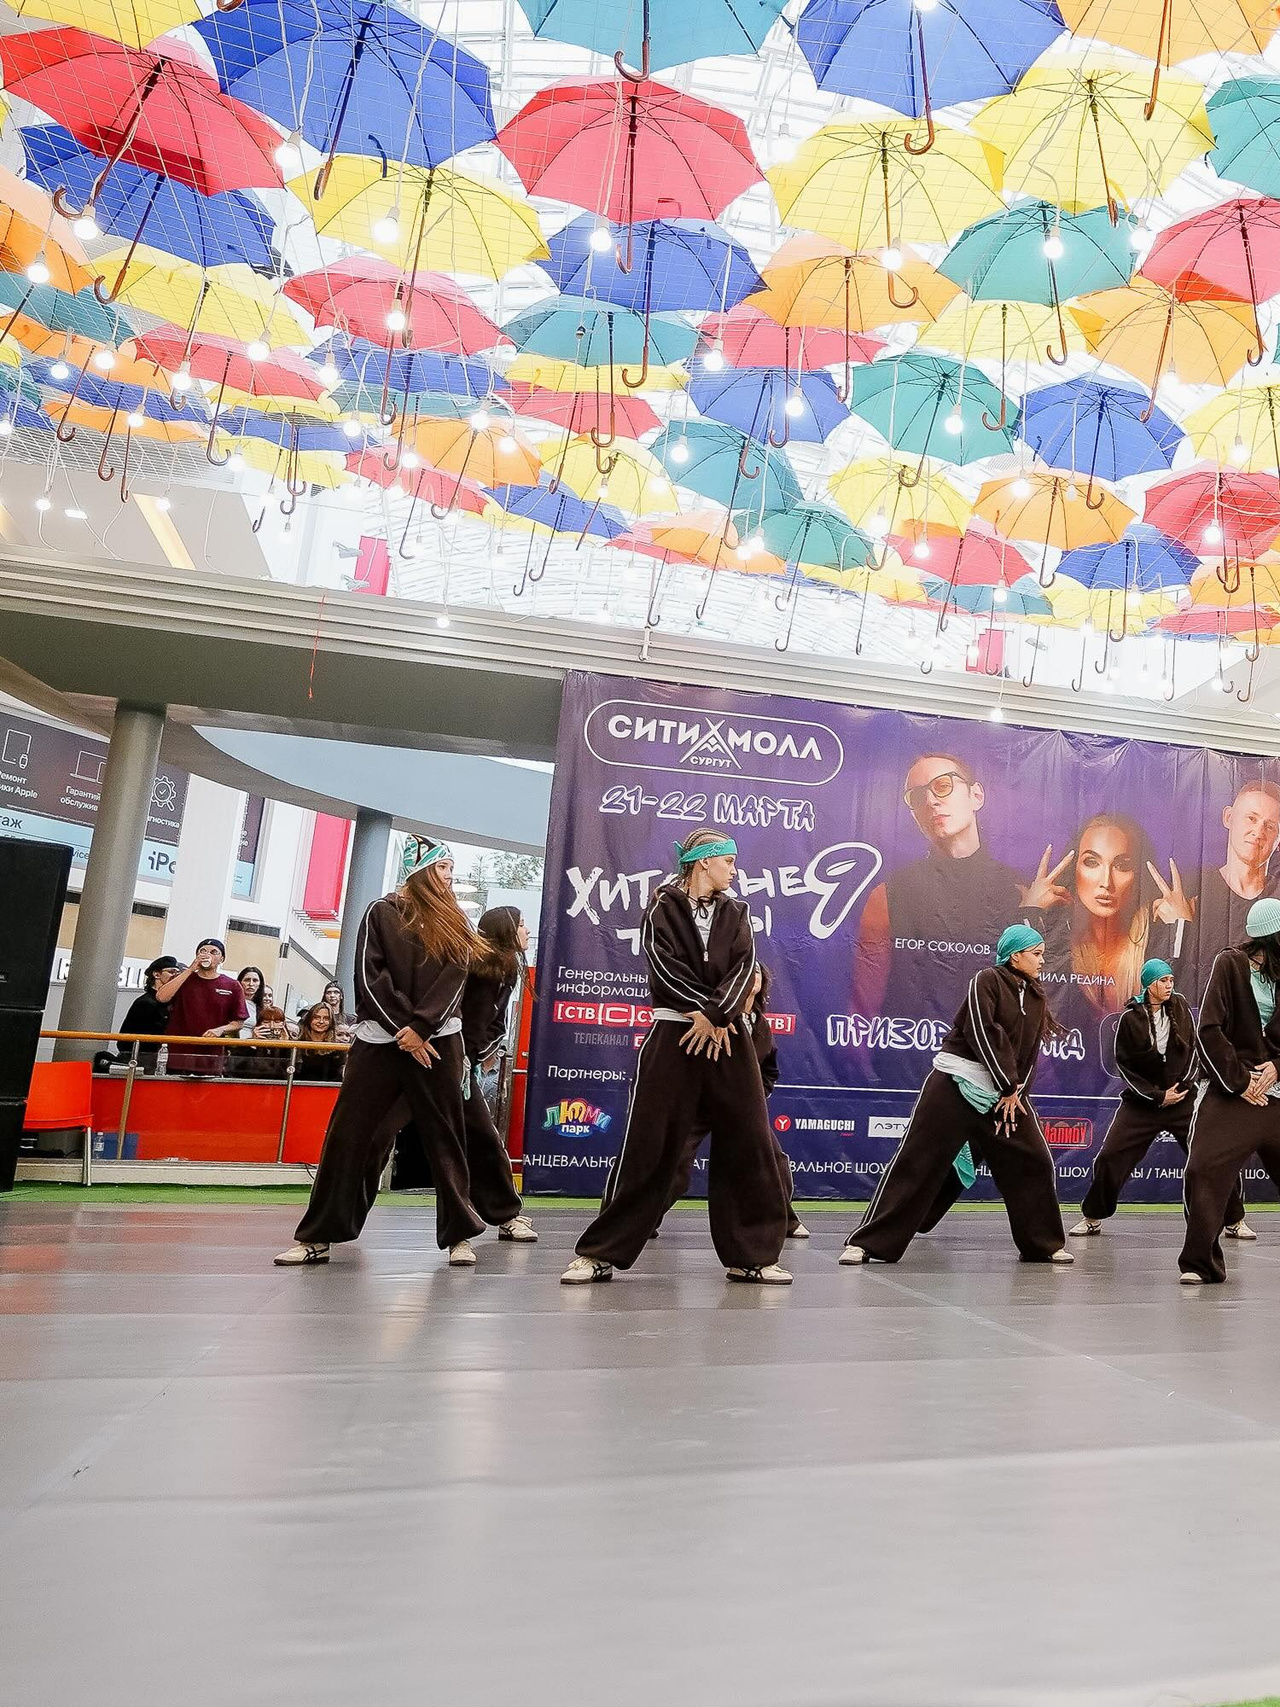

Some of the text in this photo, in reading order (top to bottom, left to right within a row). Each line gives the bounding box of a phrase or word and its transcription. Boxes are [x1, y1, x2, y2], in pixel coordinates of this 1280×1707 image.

[690, 756, 731, 769] СУРГУТ
[0, 771, 27, 784] емонт
[14, 786, 38, 799] Apple
[65, 785, 101, 801] Гарантий
[60, 797, 99, 812] обслужив
[599, 785, 816, 832] 21-22 МАРТА
[147, 816, 180, 829] гностика
[72, 849, 90, 860] vice
[895, 938, 991, 955] ЕГОР СОКОЛОВ
[558, 966, 649, 983] Генеральны
[1070, 973, 1116, 986] РЕДИНА
[556, 982, 651, 998] информаци
[574, 1032, 629, 1046] ТЕЛЕКАНАЛ
[826, 1013, 953, 1051] ПРИЗОВ
[547, 1065, 627, 1082] Партнеры:
[561, 1124, 590, 1135] парк
[795, 1118, 855, 1132] YAMAGUCHI
[874, 1122, 909, 1133] ЛЭТУ
[789, 1161, 852, 1174] ВАЛЬНОЕ
[1059, 1166, 1090, 1178] ШОУ
